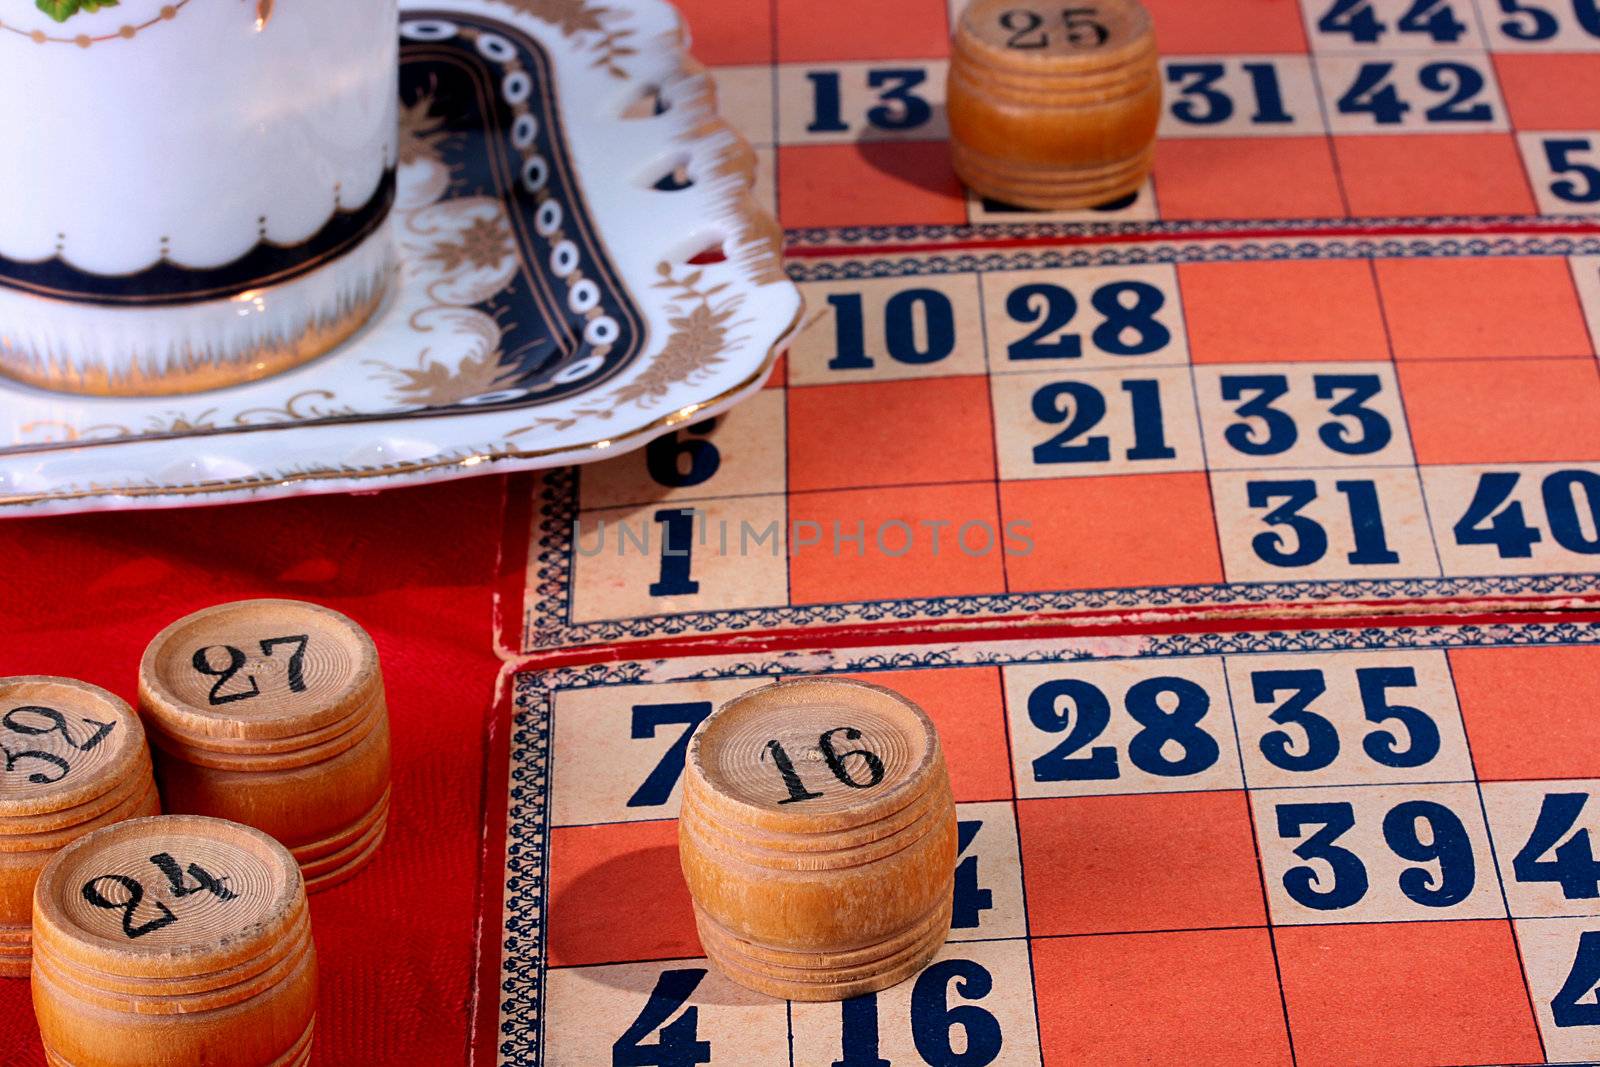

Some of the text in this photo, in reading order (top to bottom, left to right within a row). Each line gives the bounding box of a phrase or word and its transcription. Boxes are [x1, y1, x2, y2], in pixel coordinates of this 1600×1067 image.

[1000, 9, 1109, 48] 25
[1319, 0, 1465, 42] 44
[807, 70, 933, 133] 13
[1167, 64, 1293, 125] 31
[1338, 63, 1493, 123] 42
[828, 289, 955, 370] 10
[1007, 282, 1170, 360] 28
[646, 416, 720, 488] 6
[1032, 380, 1175, 464] 21
[1221, 375, 1391, 455] 33
[650, 508, 698, 596] 1
[1247, 480, 1399, 567] 31
[1454, 470, 1600, 558] 40
[192, 634, 309, 705] 27
[627, 702, 712, 807] 7
[1028, 677, 1219, 782] 28
[1251, 667, 1440, 771] 35
[761, 727, 886, 805] 16
[82, 853, 239, 939] 24
[1276, 801, 1475, 910] 39
[613, 969, 710, 1067] 4
